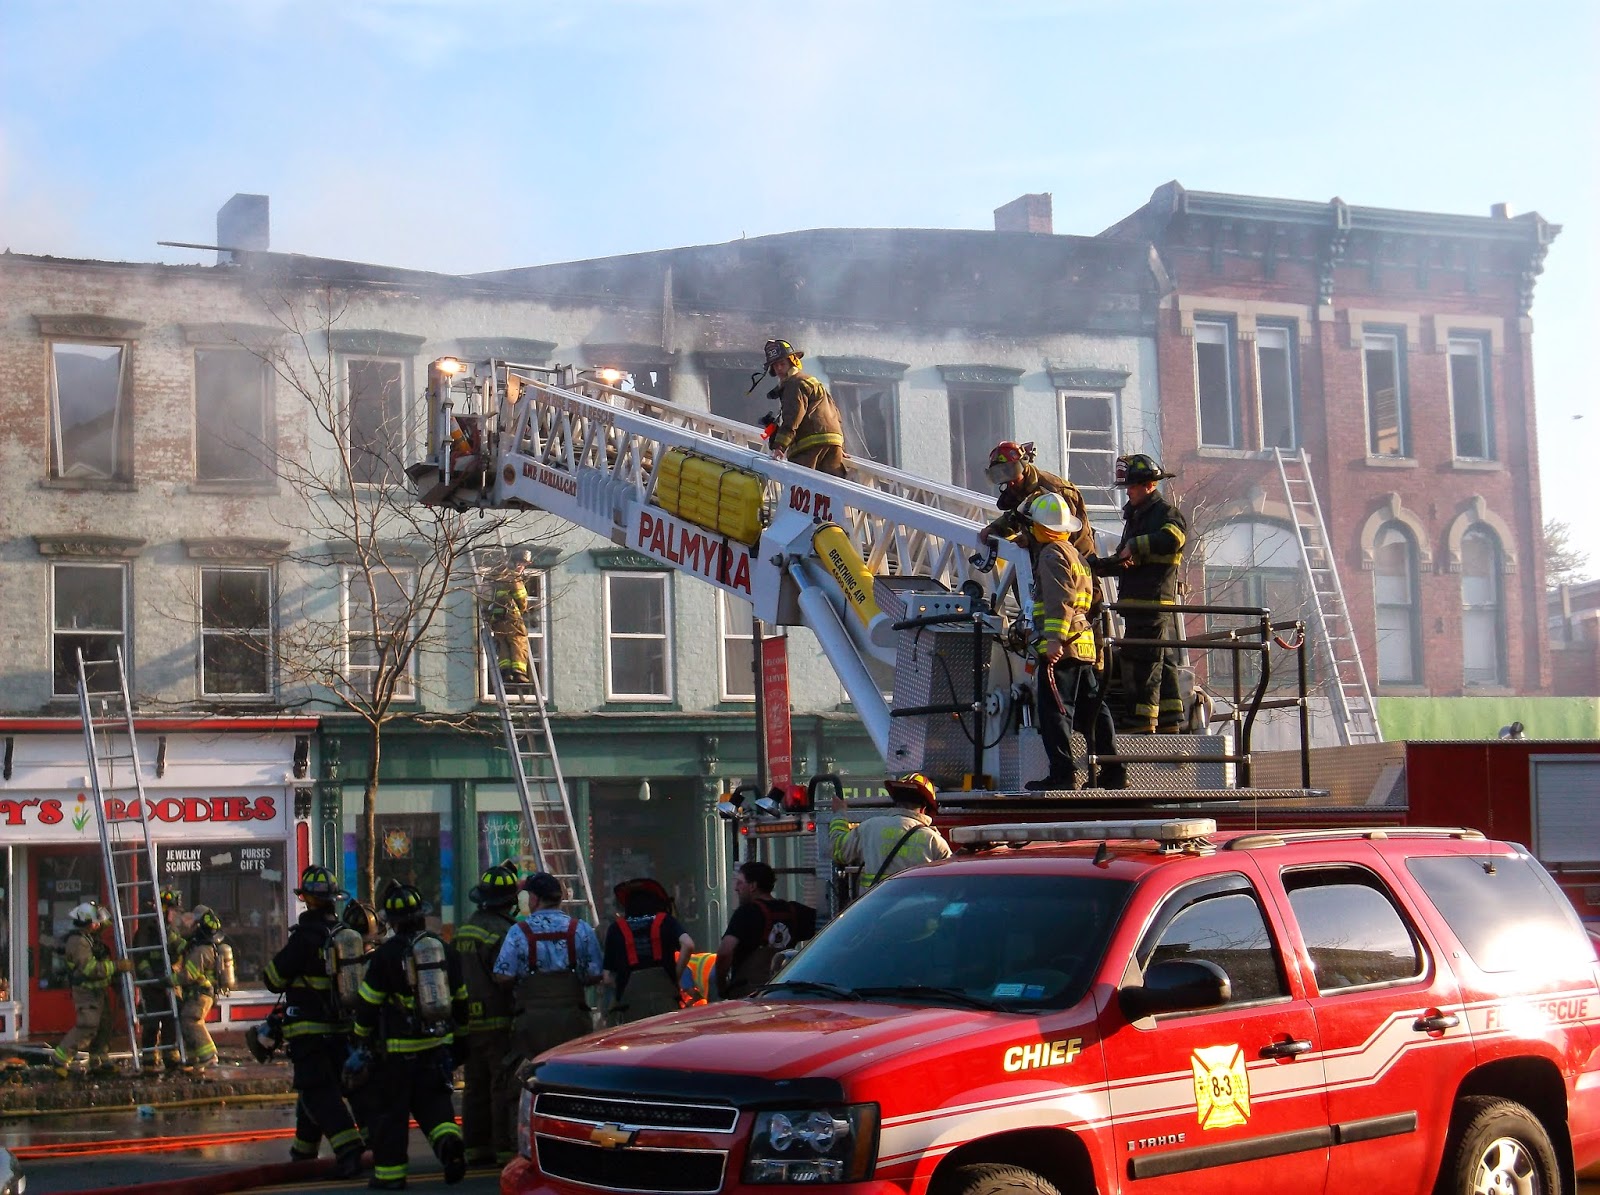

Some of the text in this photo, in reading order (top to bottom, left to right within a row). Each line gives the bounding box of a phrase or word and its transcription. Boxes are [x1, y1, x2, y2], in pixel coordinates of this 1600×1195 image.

[789, 485, 833, 522] 102 FT.
[638, 511, 752, 596] PALMYRA
[828, 548, 866, 605] BREATHING AIR
[165, 859, 265, 872] SCARVES GIFTS
[166, 848, 271, 861] JEWELRY PURSES
[57, 882, 80, 890] OPEN
[1532, 998, 1588, 1022] ESCUE
[1003, 1037, 1082, 1073] CHIEF
[1139, 1132, 1186, 1149] TAHOE
